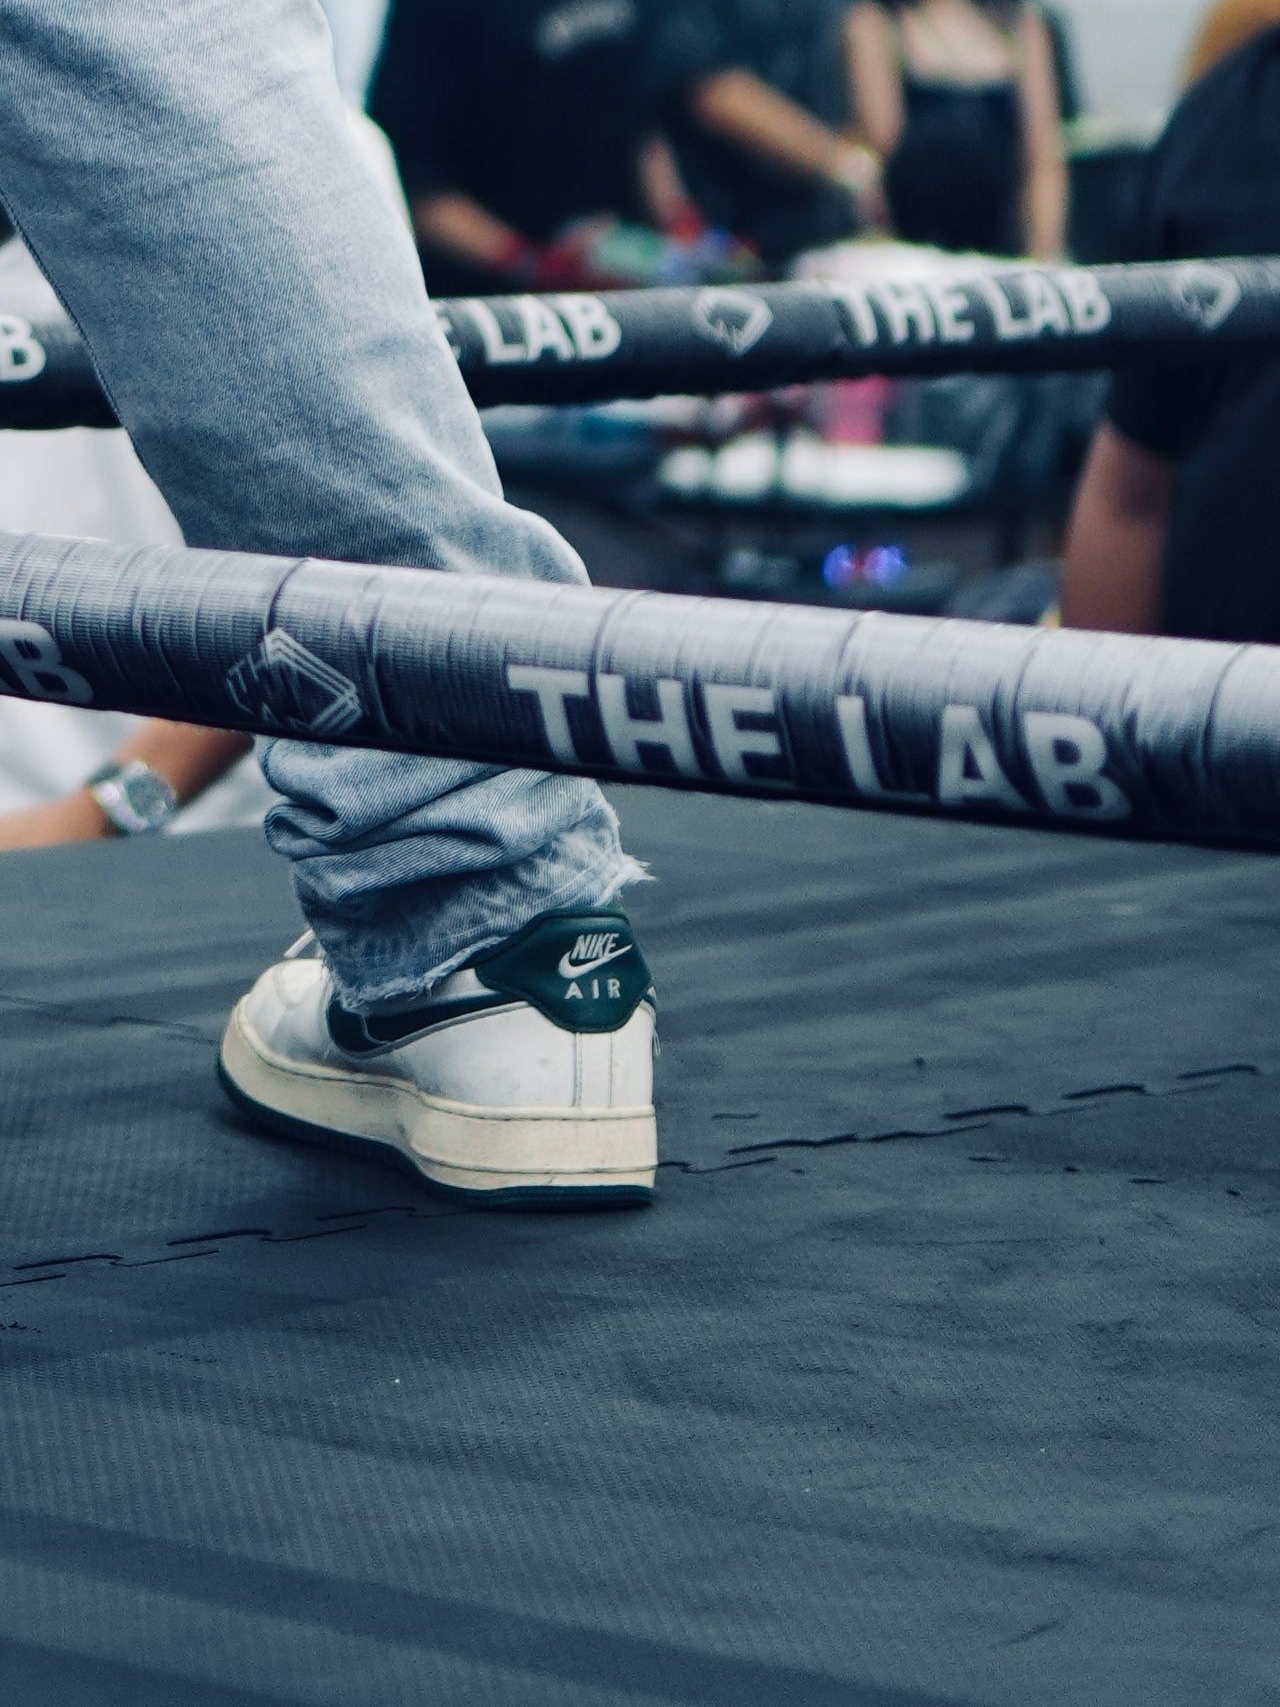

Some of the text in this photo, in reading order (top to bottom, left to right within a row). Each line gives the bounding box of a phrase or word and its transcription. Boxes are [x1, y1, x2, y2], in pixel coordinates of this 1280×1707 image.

[463, 293, 622, 364] LAB
[830, 279, 976, 348] THE
[981, 267, 1113, 341] LAB
[507, 664, 1133, 822] THE LAB
[571, 933, 620, 960] NIKE
[564, 978, 621, 1000] AIR
